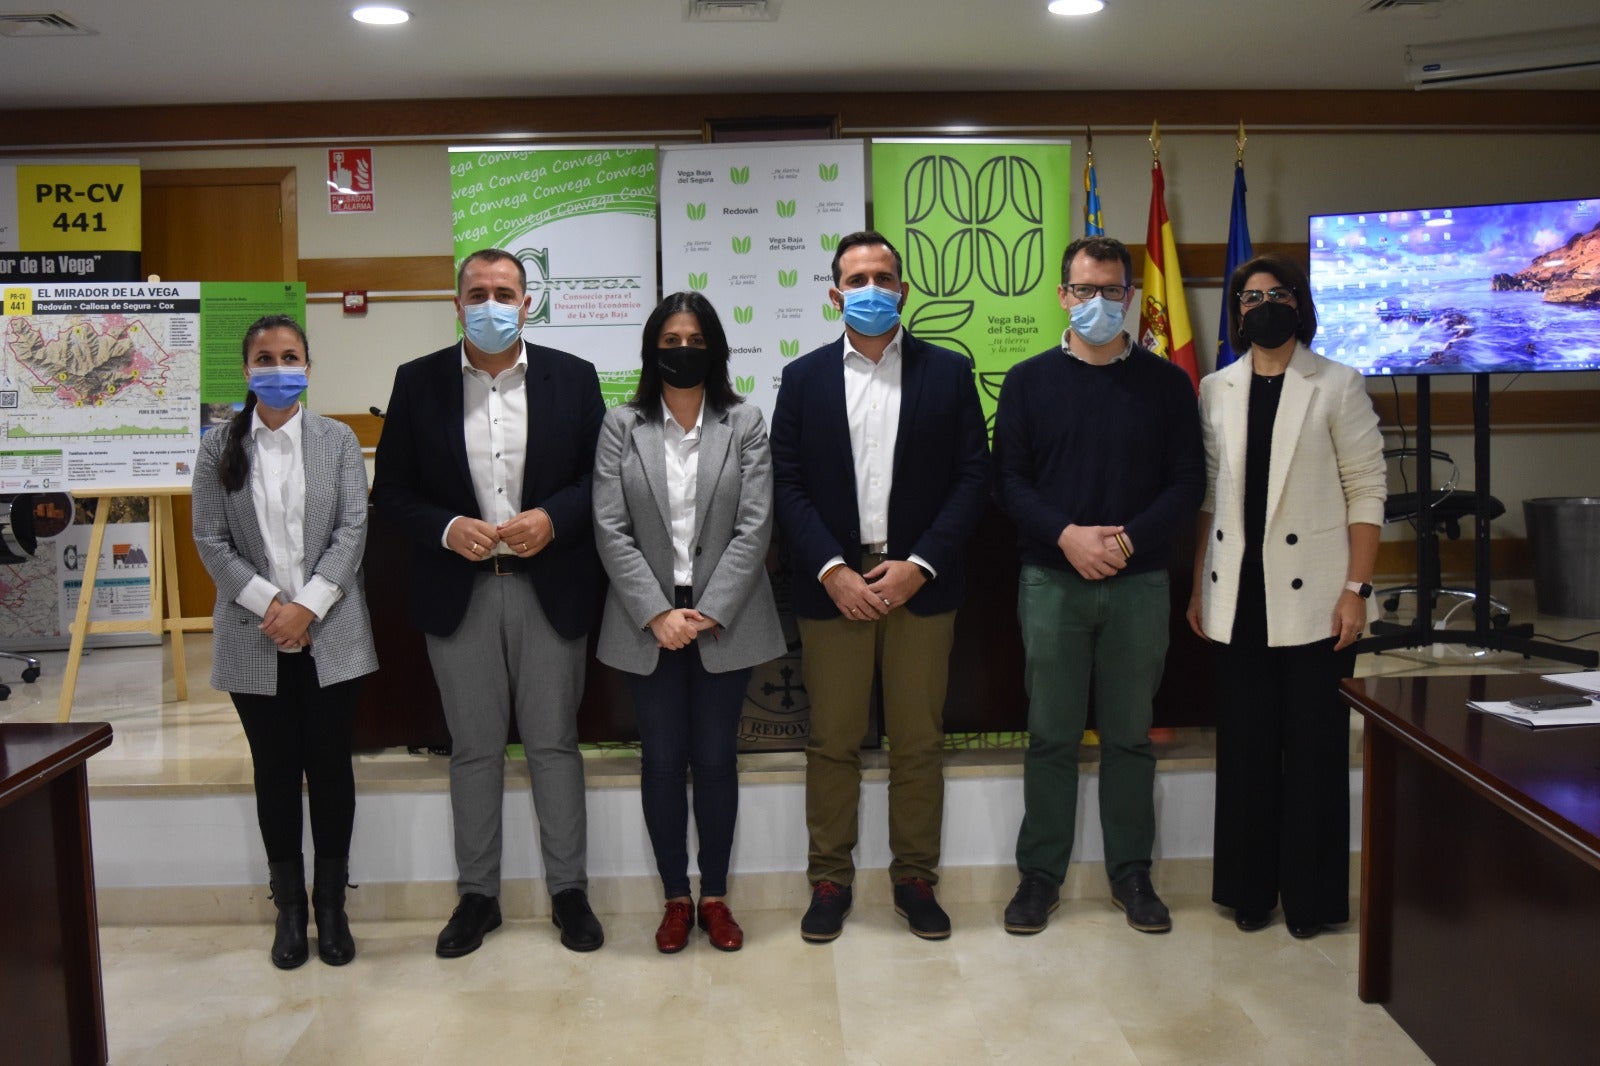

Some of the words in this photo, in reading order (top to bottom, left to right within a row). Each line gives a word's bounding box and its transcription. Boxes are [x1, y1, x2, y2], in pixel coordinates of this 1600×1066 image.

[489, 167, 547, 189] Convega
[552, 151, 611, 173] Convega
[690, 177, 714, 185] Segura
[36, 183, 124, 203] PR-CV
[470, 193, 528, 215] Convega
[533, 177, 592, 199] Convega
[597, 162, 655, 184] Convega
[494, 210, 551, 232] Convega
[557, 194, 614, 216] Convega
[620, 184, 656, 200] Conv
[723, 206, 758, 215] Redován
[53, 213, 107, 232] 441
[20, 256, 38, 274] de
[41, 256, 55, 273] la
[38, 289, 51, 297] EL
[55, 288, 109, 297] MIRADOR
[113, 288, 127, 297] DE
[130, 288, 145, 297] LA
[148, 287, 179, 297] VEGA
[605, 294, 622, 302] para
[11, 302, 25, 310] 441
[111, 302, 121, 310] de
[123, 302, 151, 311] Segura
[159, 302, 174, 310] Cox
[554, 302, 597, 310] Desarrollo
[598, 301, 641, 309] Económico
[589, 312, 608, 320] Vega
[611, 311, 628, 319] Baja
[988, 316, 1011, 325] Vega
[1014, 315, 1035, 325] Baja
[988, 326, 1002, 334] del
[1005, 326, 1038, 335] Segura
